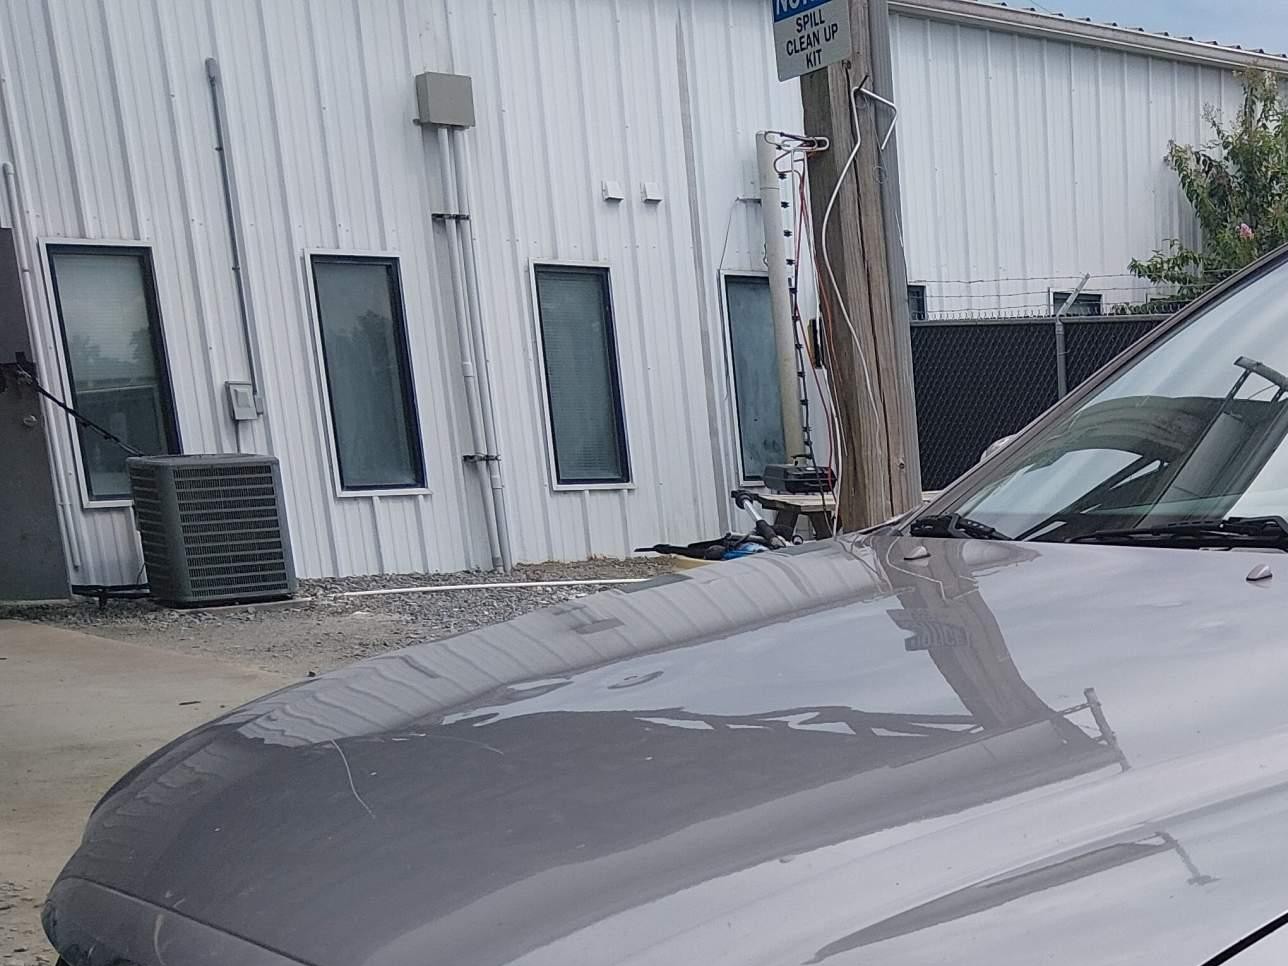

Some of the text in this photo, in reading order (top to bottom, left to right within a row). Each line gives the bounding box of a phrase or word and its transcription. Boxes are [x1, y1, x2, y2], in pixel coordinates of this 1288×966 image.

[796, 9, 825, 33] SPILL
[786, 23, 838, 56] CLEAN UP
[806, 48, 822, 68] KIT
